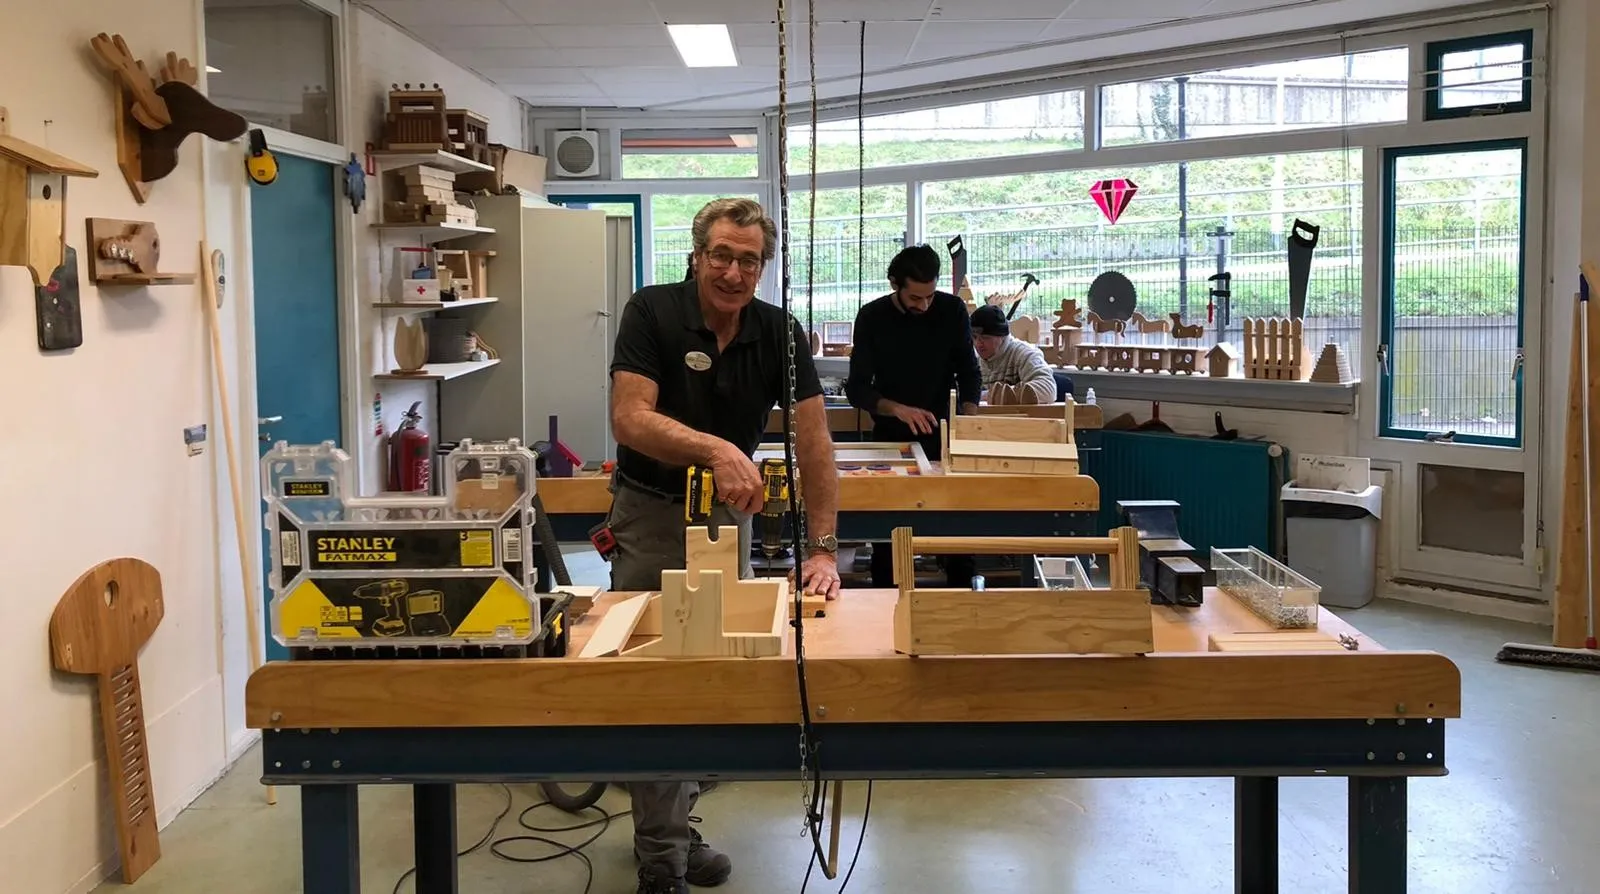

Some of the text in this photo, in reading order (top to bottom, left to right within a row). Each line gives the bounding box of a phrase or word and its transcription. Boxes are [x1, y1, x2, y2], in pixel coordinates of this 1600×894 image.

[461, 531, 468, 541] 3
[317, 537, 395, 550] STANLEY
[325, 553, 388, 561] FATMAX
